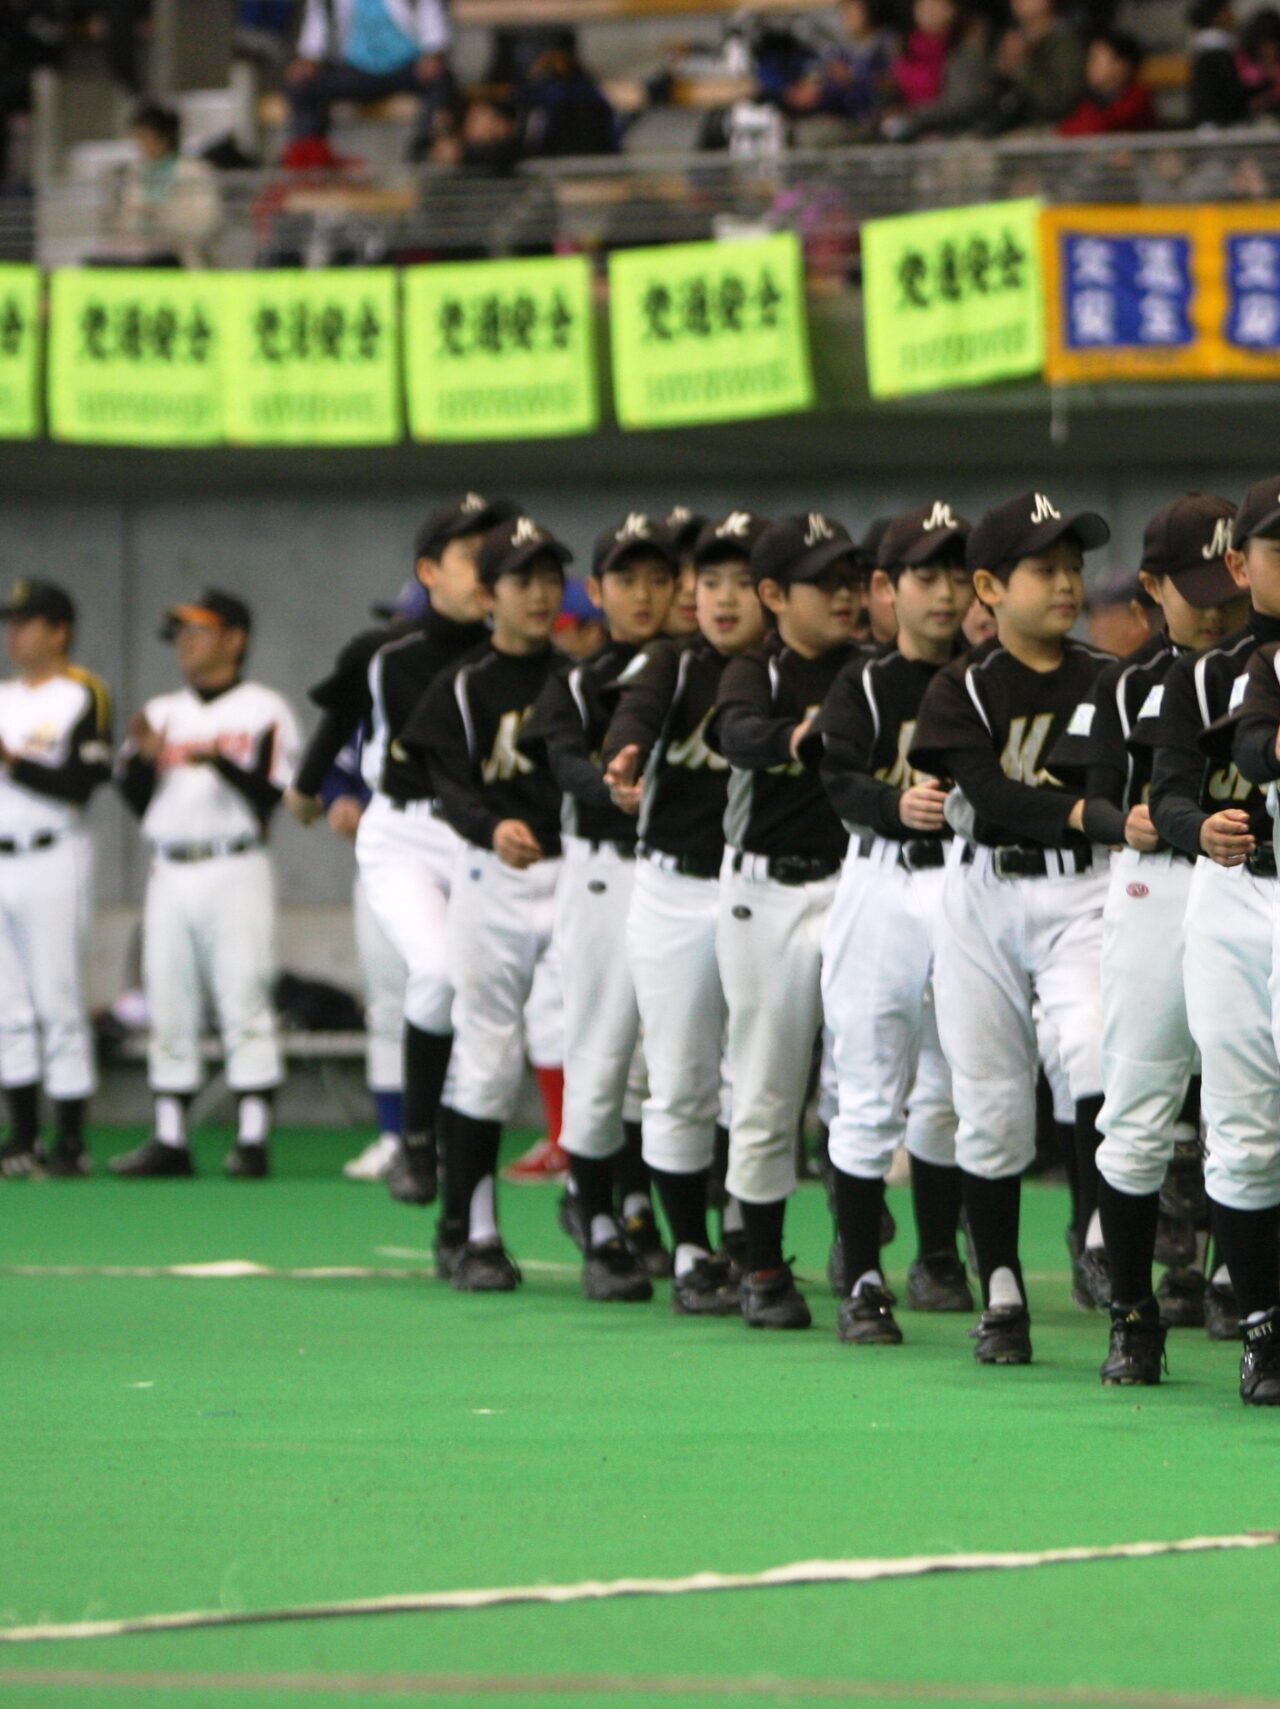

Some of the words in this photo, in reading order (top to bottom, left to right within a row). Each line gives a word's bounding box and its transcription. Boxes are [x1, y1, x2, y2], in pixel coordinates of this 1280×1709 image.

[923, 501, 958, 531] M
[1031, 493, 1061, 525] M
[511, 516, 543, 548] M
[615, 512, 650, 541] M
[804, 513, 834, 547] M
[1202, 517, 1233, 560] M
